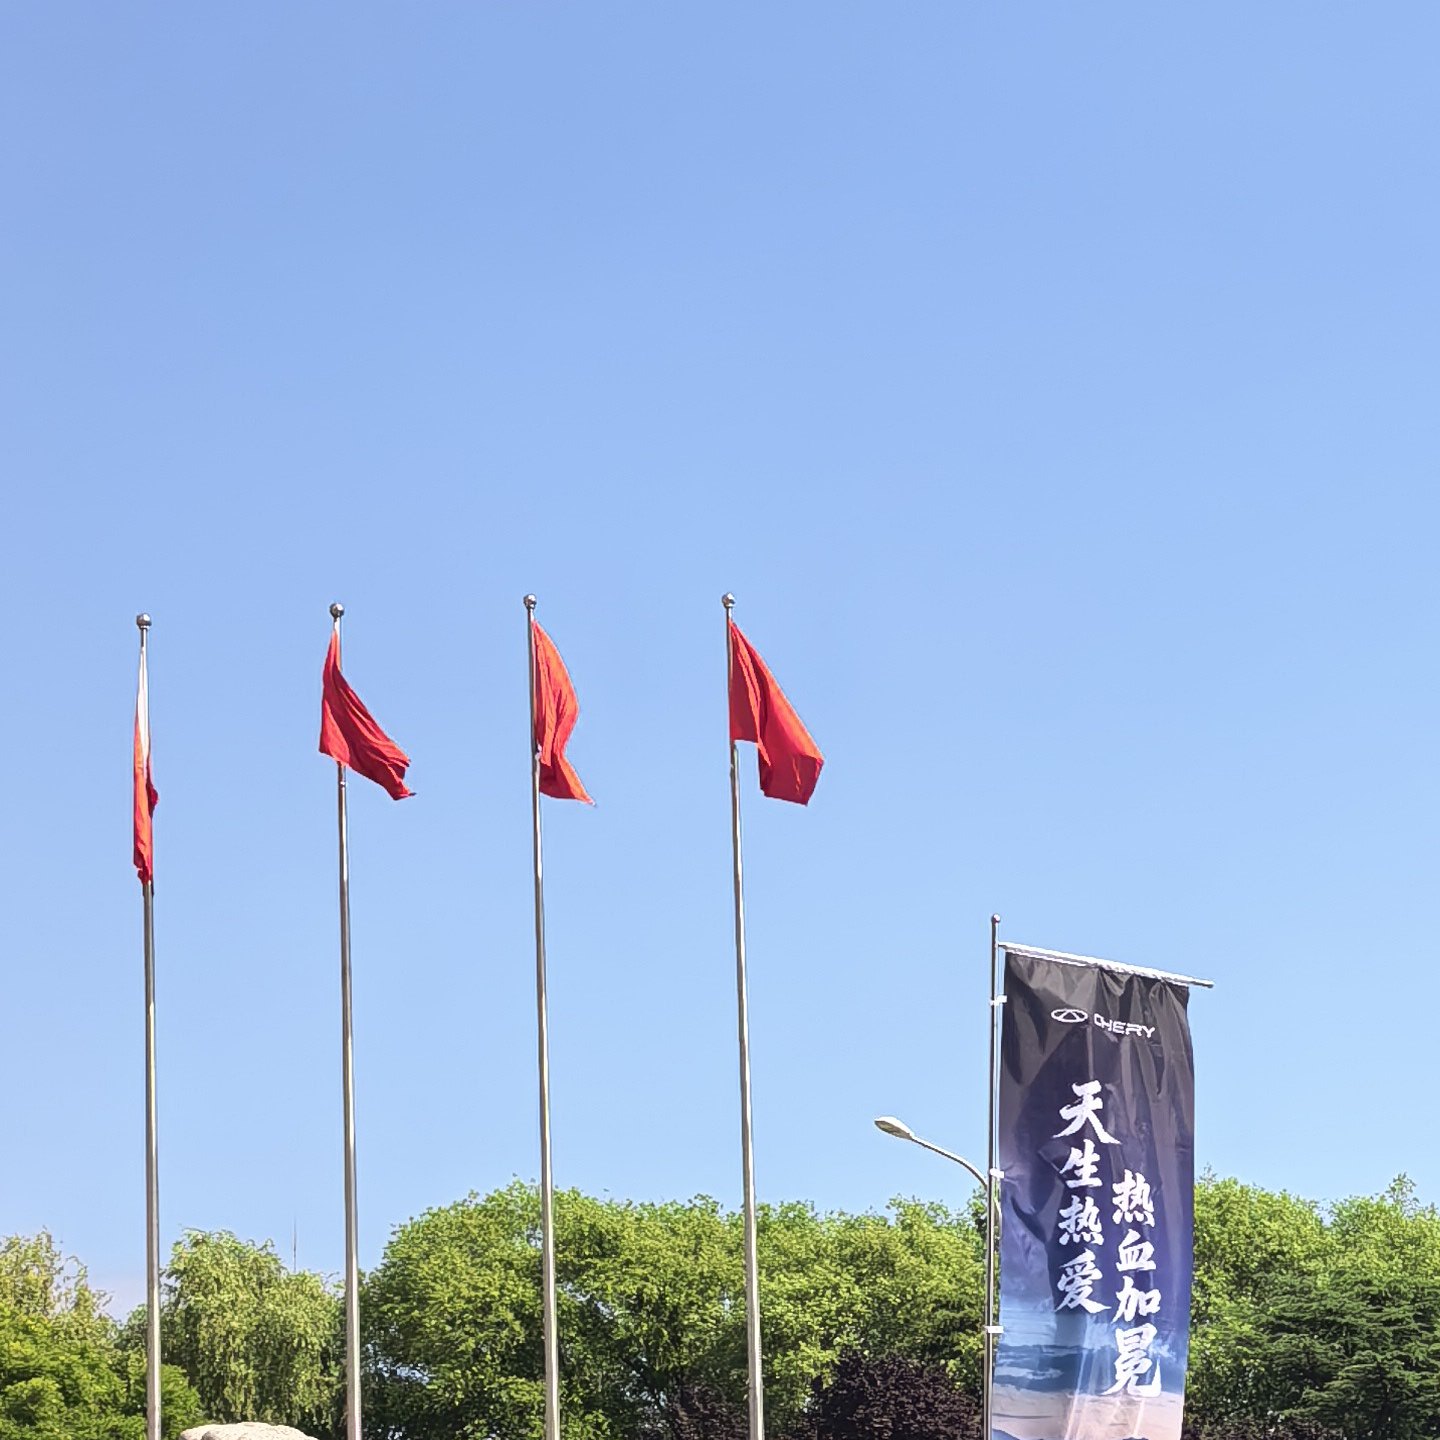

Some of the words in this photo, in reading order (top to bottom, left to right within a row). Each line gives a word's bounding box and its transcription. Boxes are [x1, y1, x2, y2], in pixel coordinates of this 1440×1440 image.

[1052, 1080, 1121, 1314] 天生热爱
[1105, 1170, 1161, 1398] 热血加冕
